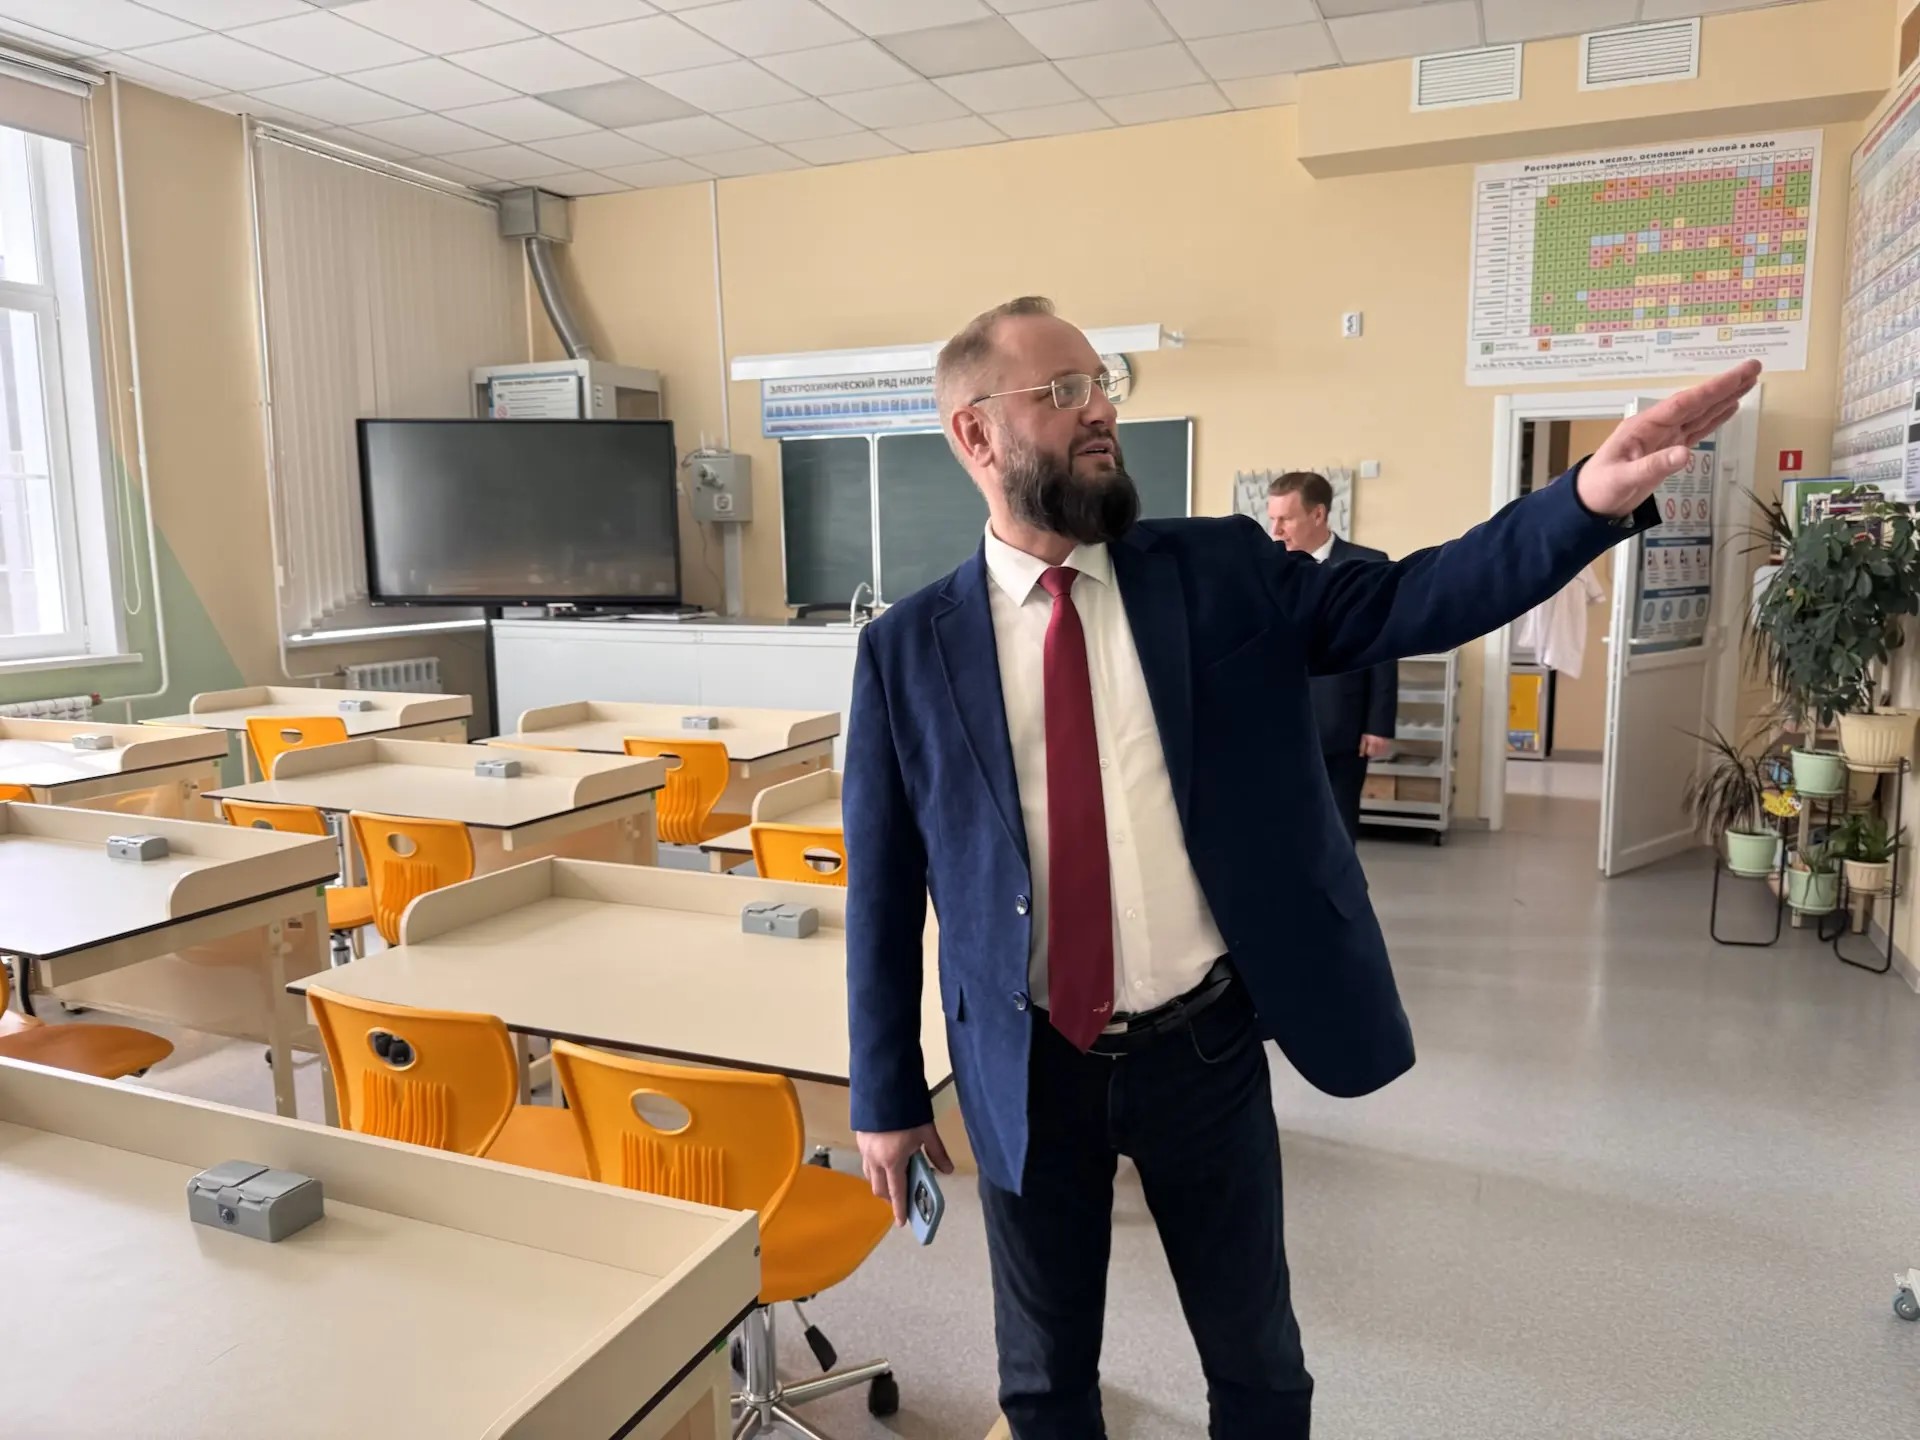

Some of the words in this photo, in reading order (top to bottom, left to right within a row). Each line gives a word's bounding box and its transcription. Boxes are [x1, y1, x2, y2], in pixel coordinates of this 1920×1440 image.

[769, 377, 876, 394] ЭЛЕКТРОХИМИЧЕСКИЙ
[878, 376, 898, 389] РЯД
[899, 375, 936, 387] НАПРЯ
